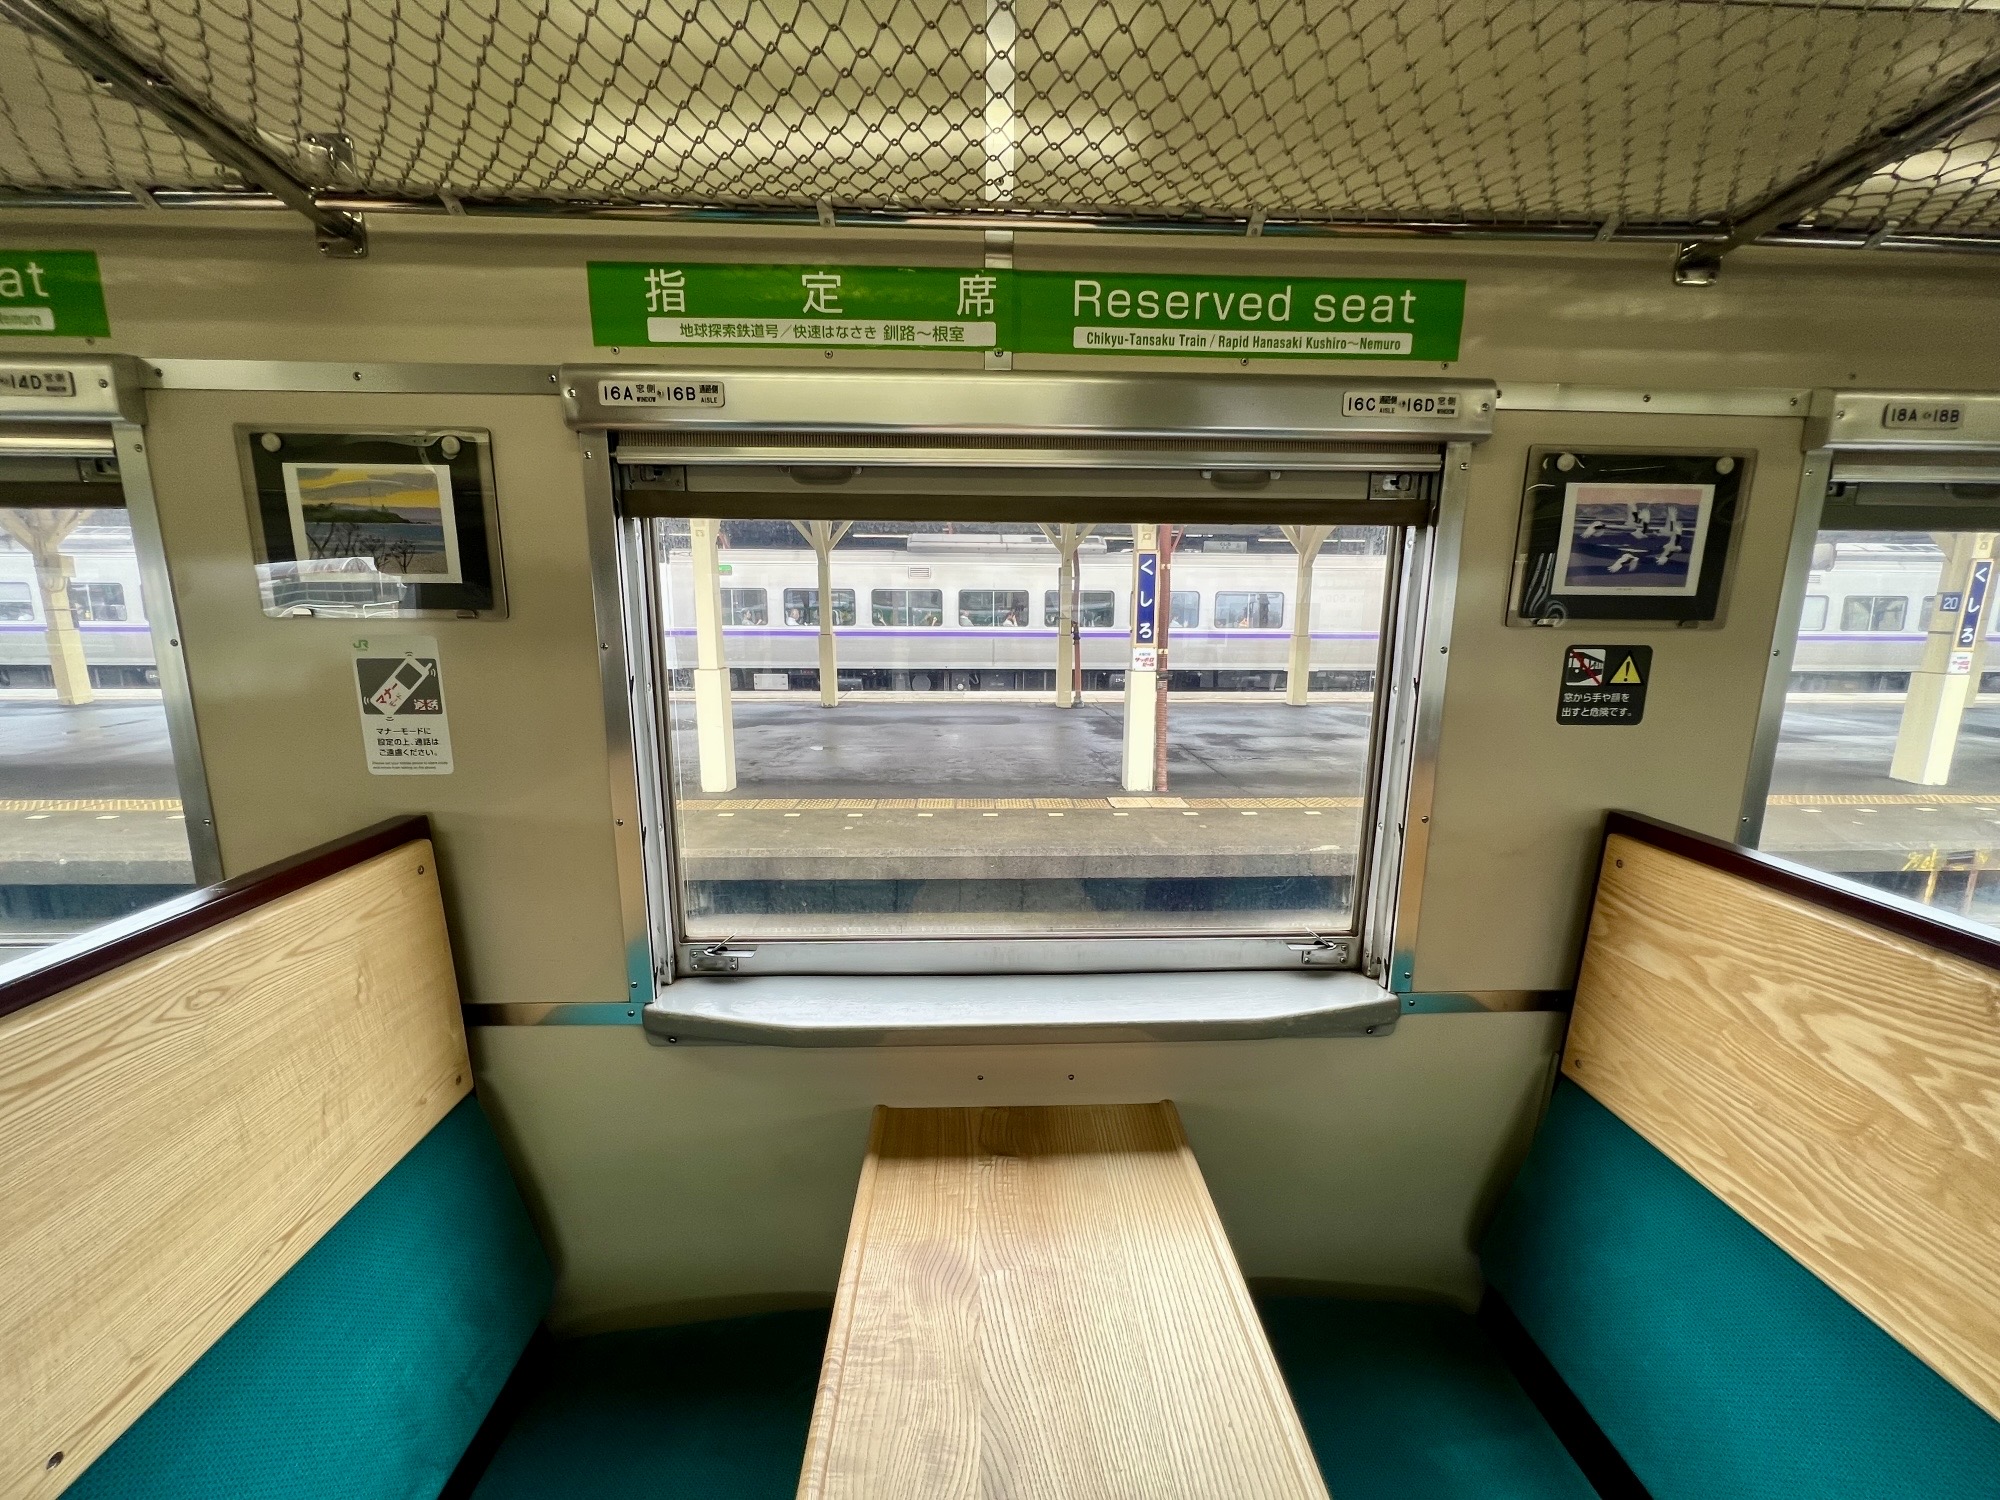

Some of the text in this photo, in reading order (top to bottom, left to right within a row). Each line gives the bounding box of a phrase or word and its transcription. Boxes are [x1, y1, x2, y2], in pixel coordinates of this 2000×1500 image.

[643, 268, 998, 318] 指定席
[1073, 280, 1417, 324] Reserved seat
[1086, 332, 1175, 347] Chikyu-Tansaku
[1179, 334, 1206, 347] Train
[1209, 335, 1215, 348] /
[1218, 335, 1249, 350] Rapid
[1253, 336, 1302, 349] Hanasaki
[11, 374, 41, 389] 14D
[604, 385, 633, 400] 16A
[667, 386, 696, 401] 16B
[1348, 397, 1376, 411] 16C
[1408, 398, 1435, 412] 16D
[1891, 408, 1960, 423] 18A 18B
[1139, 559, 1154, 638] くしろ
[1943, 597, 1959, 610] 20
[1961, 567, 1988, 643] くしろ
[352, 639, 369, 649] JR
[376, 683, 397, 704] マナー
